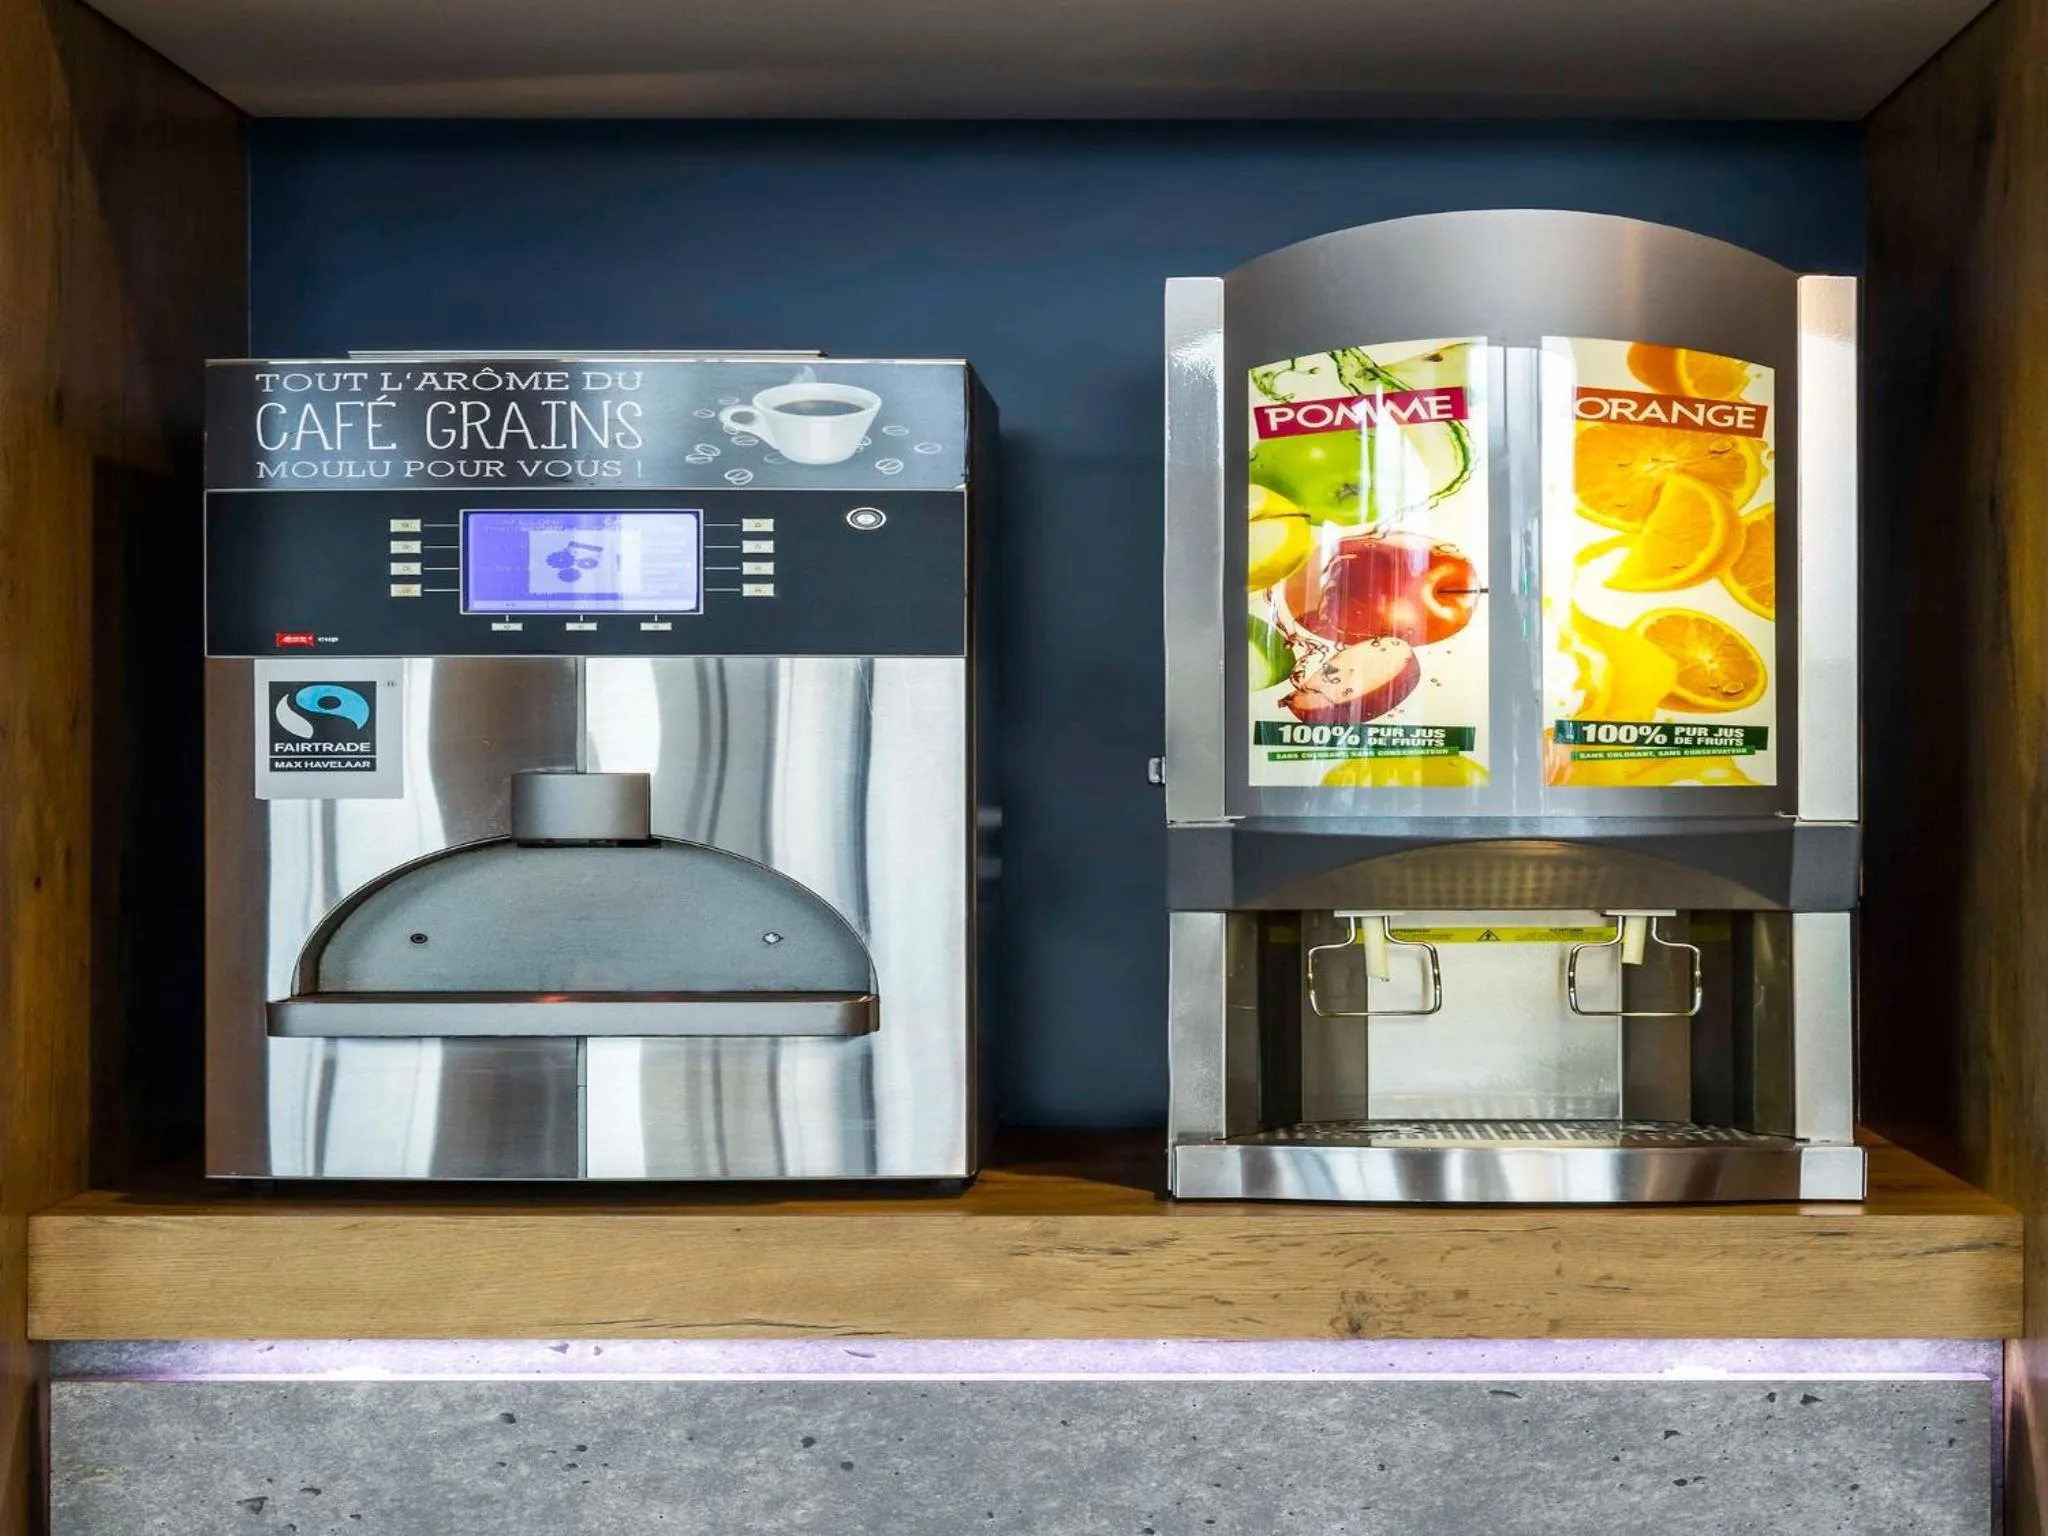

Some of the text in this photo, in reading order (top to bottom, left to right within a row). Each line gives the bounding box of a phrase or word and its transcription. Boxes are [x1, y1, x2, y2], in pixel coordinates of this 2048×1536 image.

[255, 366, 643, 392] TOUT L'ARÔME DU
[255, 394, 643, 451] CAFÉ GRAINS
[1264, 395, 1453, 432] POMME
[1575, 396, 1755, 429] ORANGE
[255, 460, 391, 479] MOULU
[404, 460, 507, 478] POUR
[517, 459, 623, 478] VOUS
[1278, 724, 1446, 745] 100% PUR JUS
[1366, 737, 1445, 747] DE FRUITS
[1582, 723, 1744, 745] 100% PUR JUS
[1674, 736, 1744, 746] DE FRUITS
[274, 741, 372, 753] FAIRTRADE
[274, 760, 371, 769] MAX HAVELAAR
